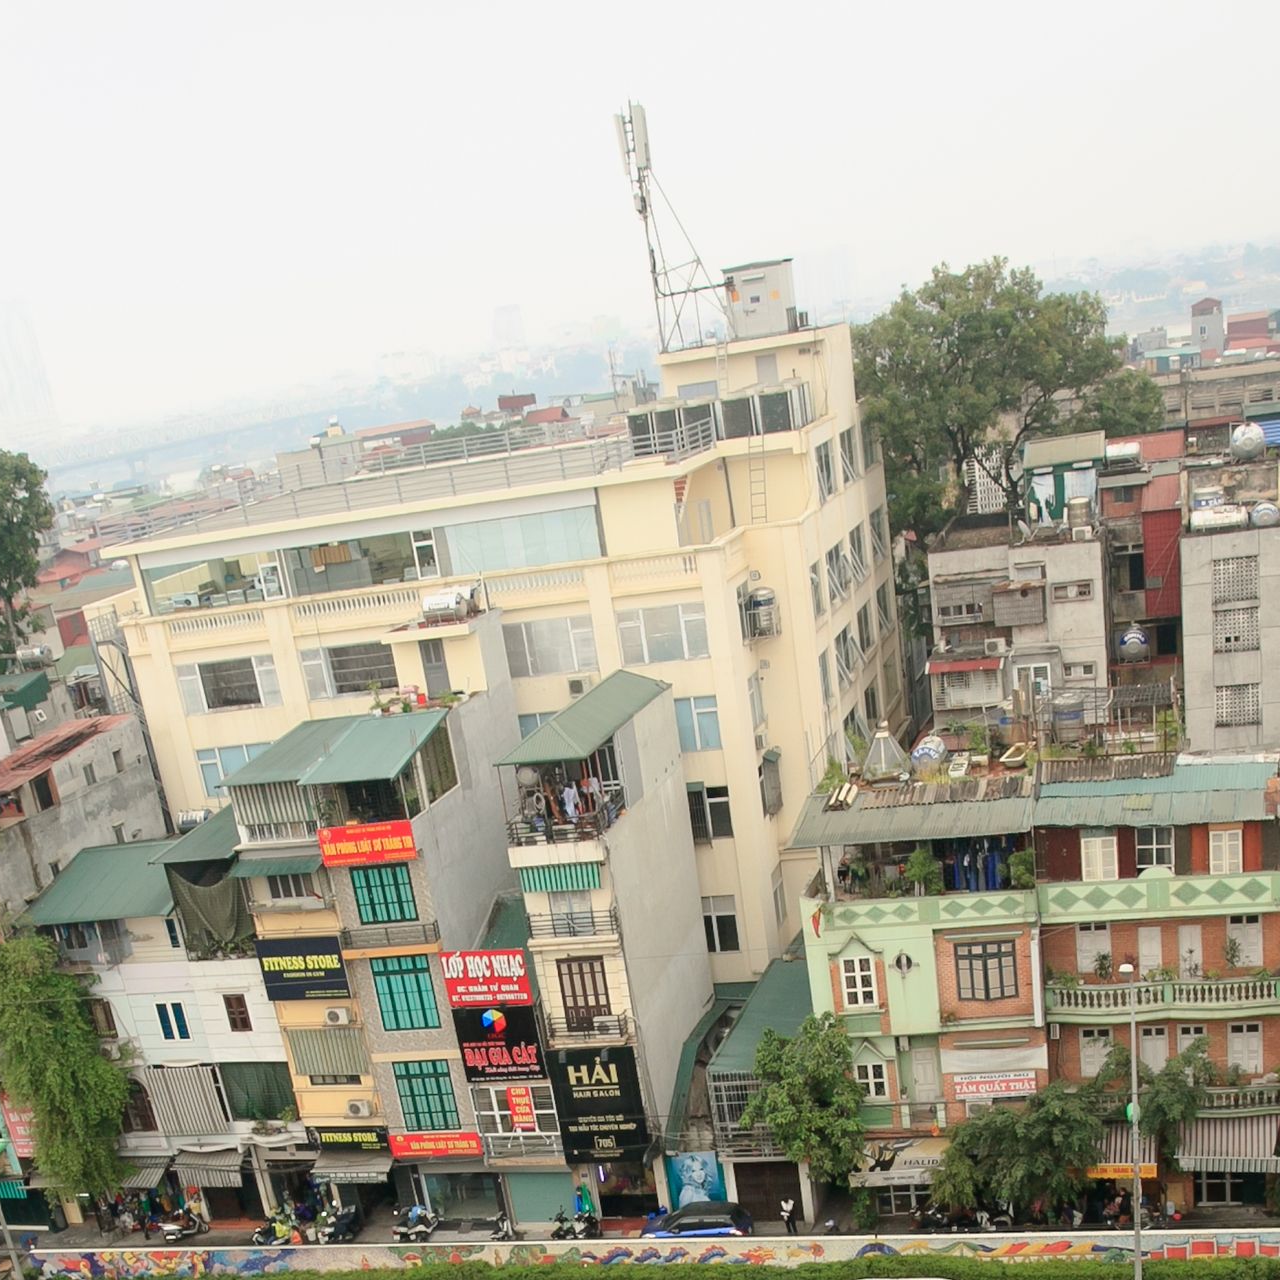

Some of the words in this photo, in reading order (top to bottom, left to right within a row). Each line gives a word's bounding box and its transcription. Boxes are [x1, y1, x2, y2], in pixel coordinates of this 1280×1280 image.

[336, 839, 358, 855] PHÒNG
[262, 955, 305, 971] FITNESS
[305, 954, 341, 969] STORE
[441, 951, 464, 979] LỚP
[465, 955, 491, 982] HỌC
[490, 954, 525, 981] NHẠC
[464, 1047, 489, 1071] ĐẠI
[488, 1046, 513, 1066] GIA
[567, 1056, 619, 1085] HẢI
[511, 1088, 526, 1096] CHO
[573, 1090, 592, 1099] HAIR
[592, 1089, 621, 1098] SALON
[512, 1096, 530, 1105] THUÊ
[513, 1114, 534, 1122] HÀNG
[321, 1132, 353, 1143] FITNESS
[353, 1132, 378, 1142] STORE
